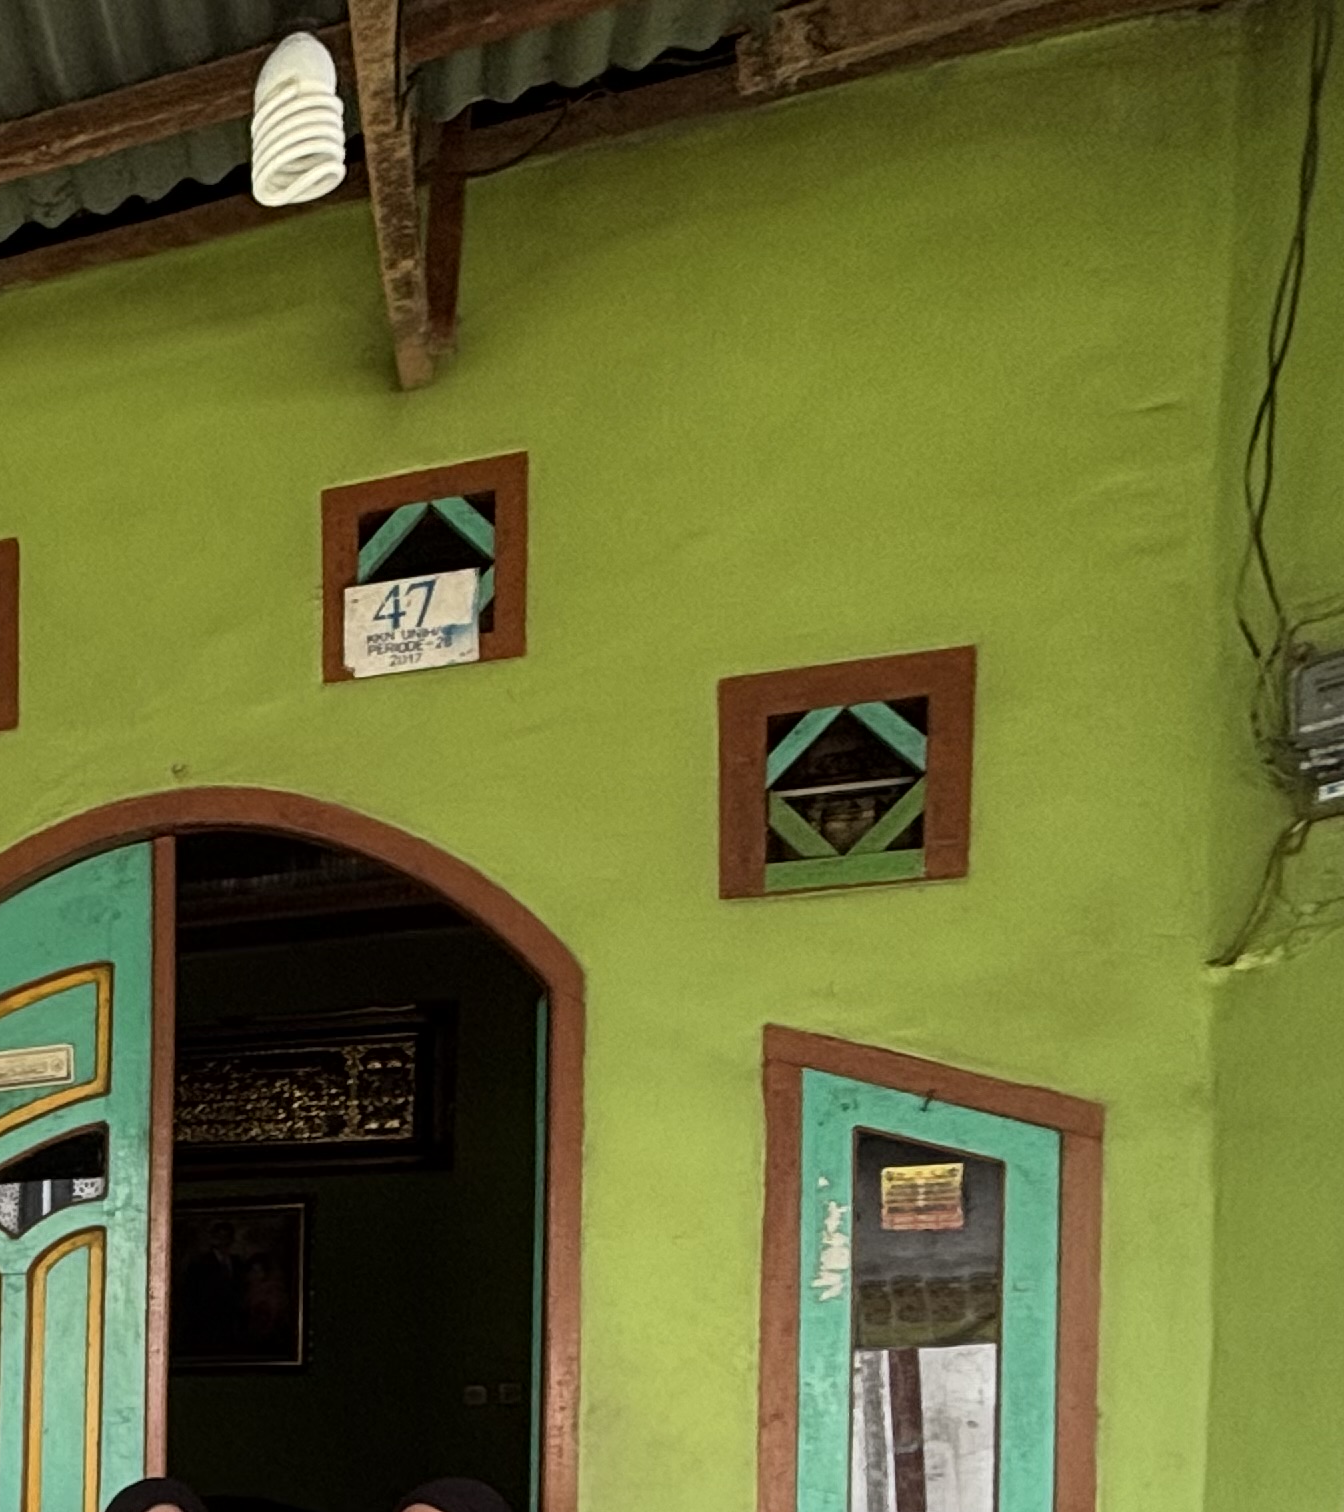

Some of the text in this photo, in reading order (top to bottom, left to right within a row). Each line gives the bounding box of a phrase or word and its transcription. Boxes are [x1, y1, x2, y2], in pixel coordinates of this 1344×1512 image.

[373, 579, 437, 630] 47
[367, 632, 395, 643] KKN
[389, 653, 422, 667] 2017
